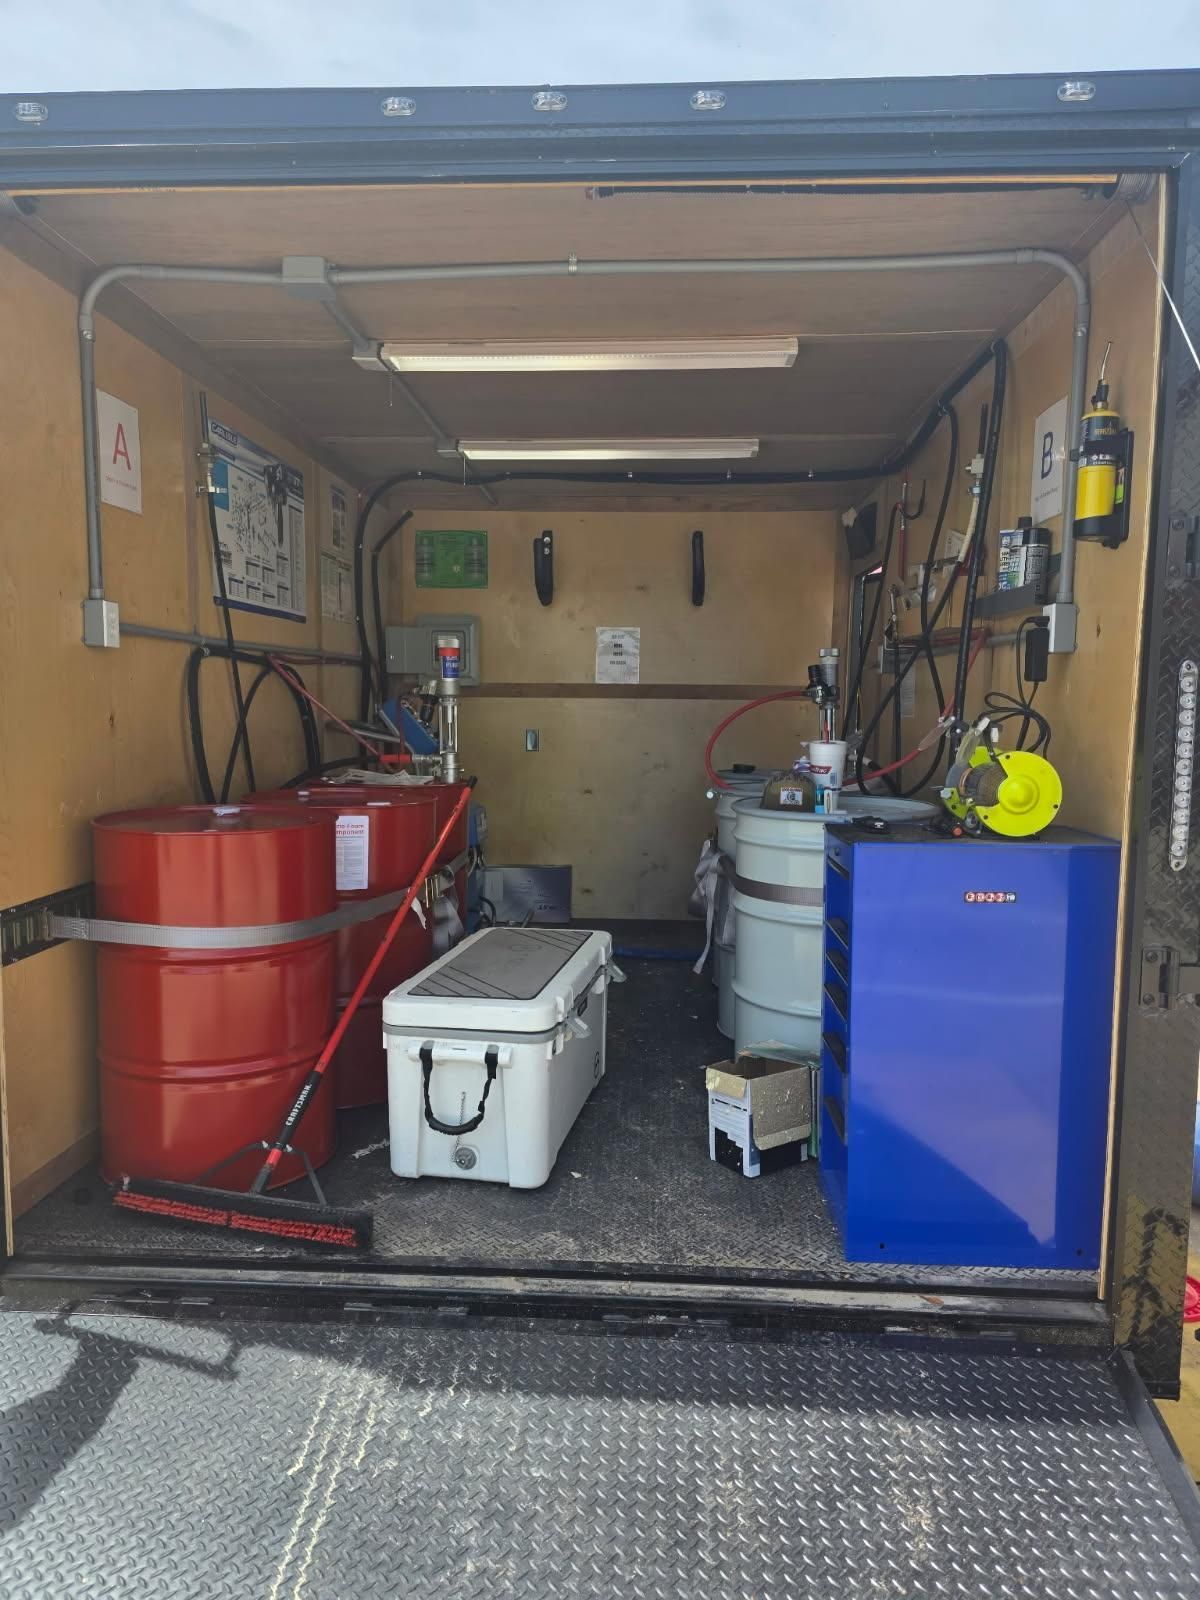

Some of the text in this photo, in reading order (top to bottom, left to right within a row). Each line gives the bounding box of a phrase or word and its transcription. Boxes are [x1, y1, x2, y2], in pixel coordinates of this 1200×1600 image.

[112, 422, 132, 471] A
[212, 423, 237, 445] CARLISLE
[1041, 431, 1054, 480] B
[285, 1083, 312, 1126] CRAFTSMAN
